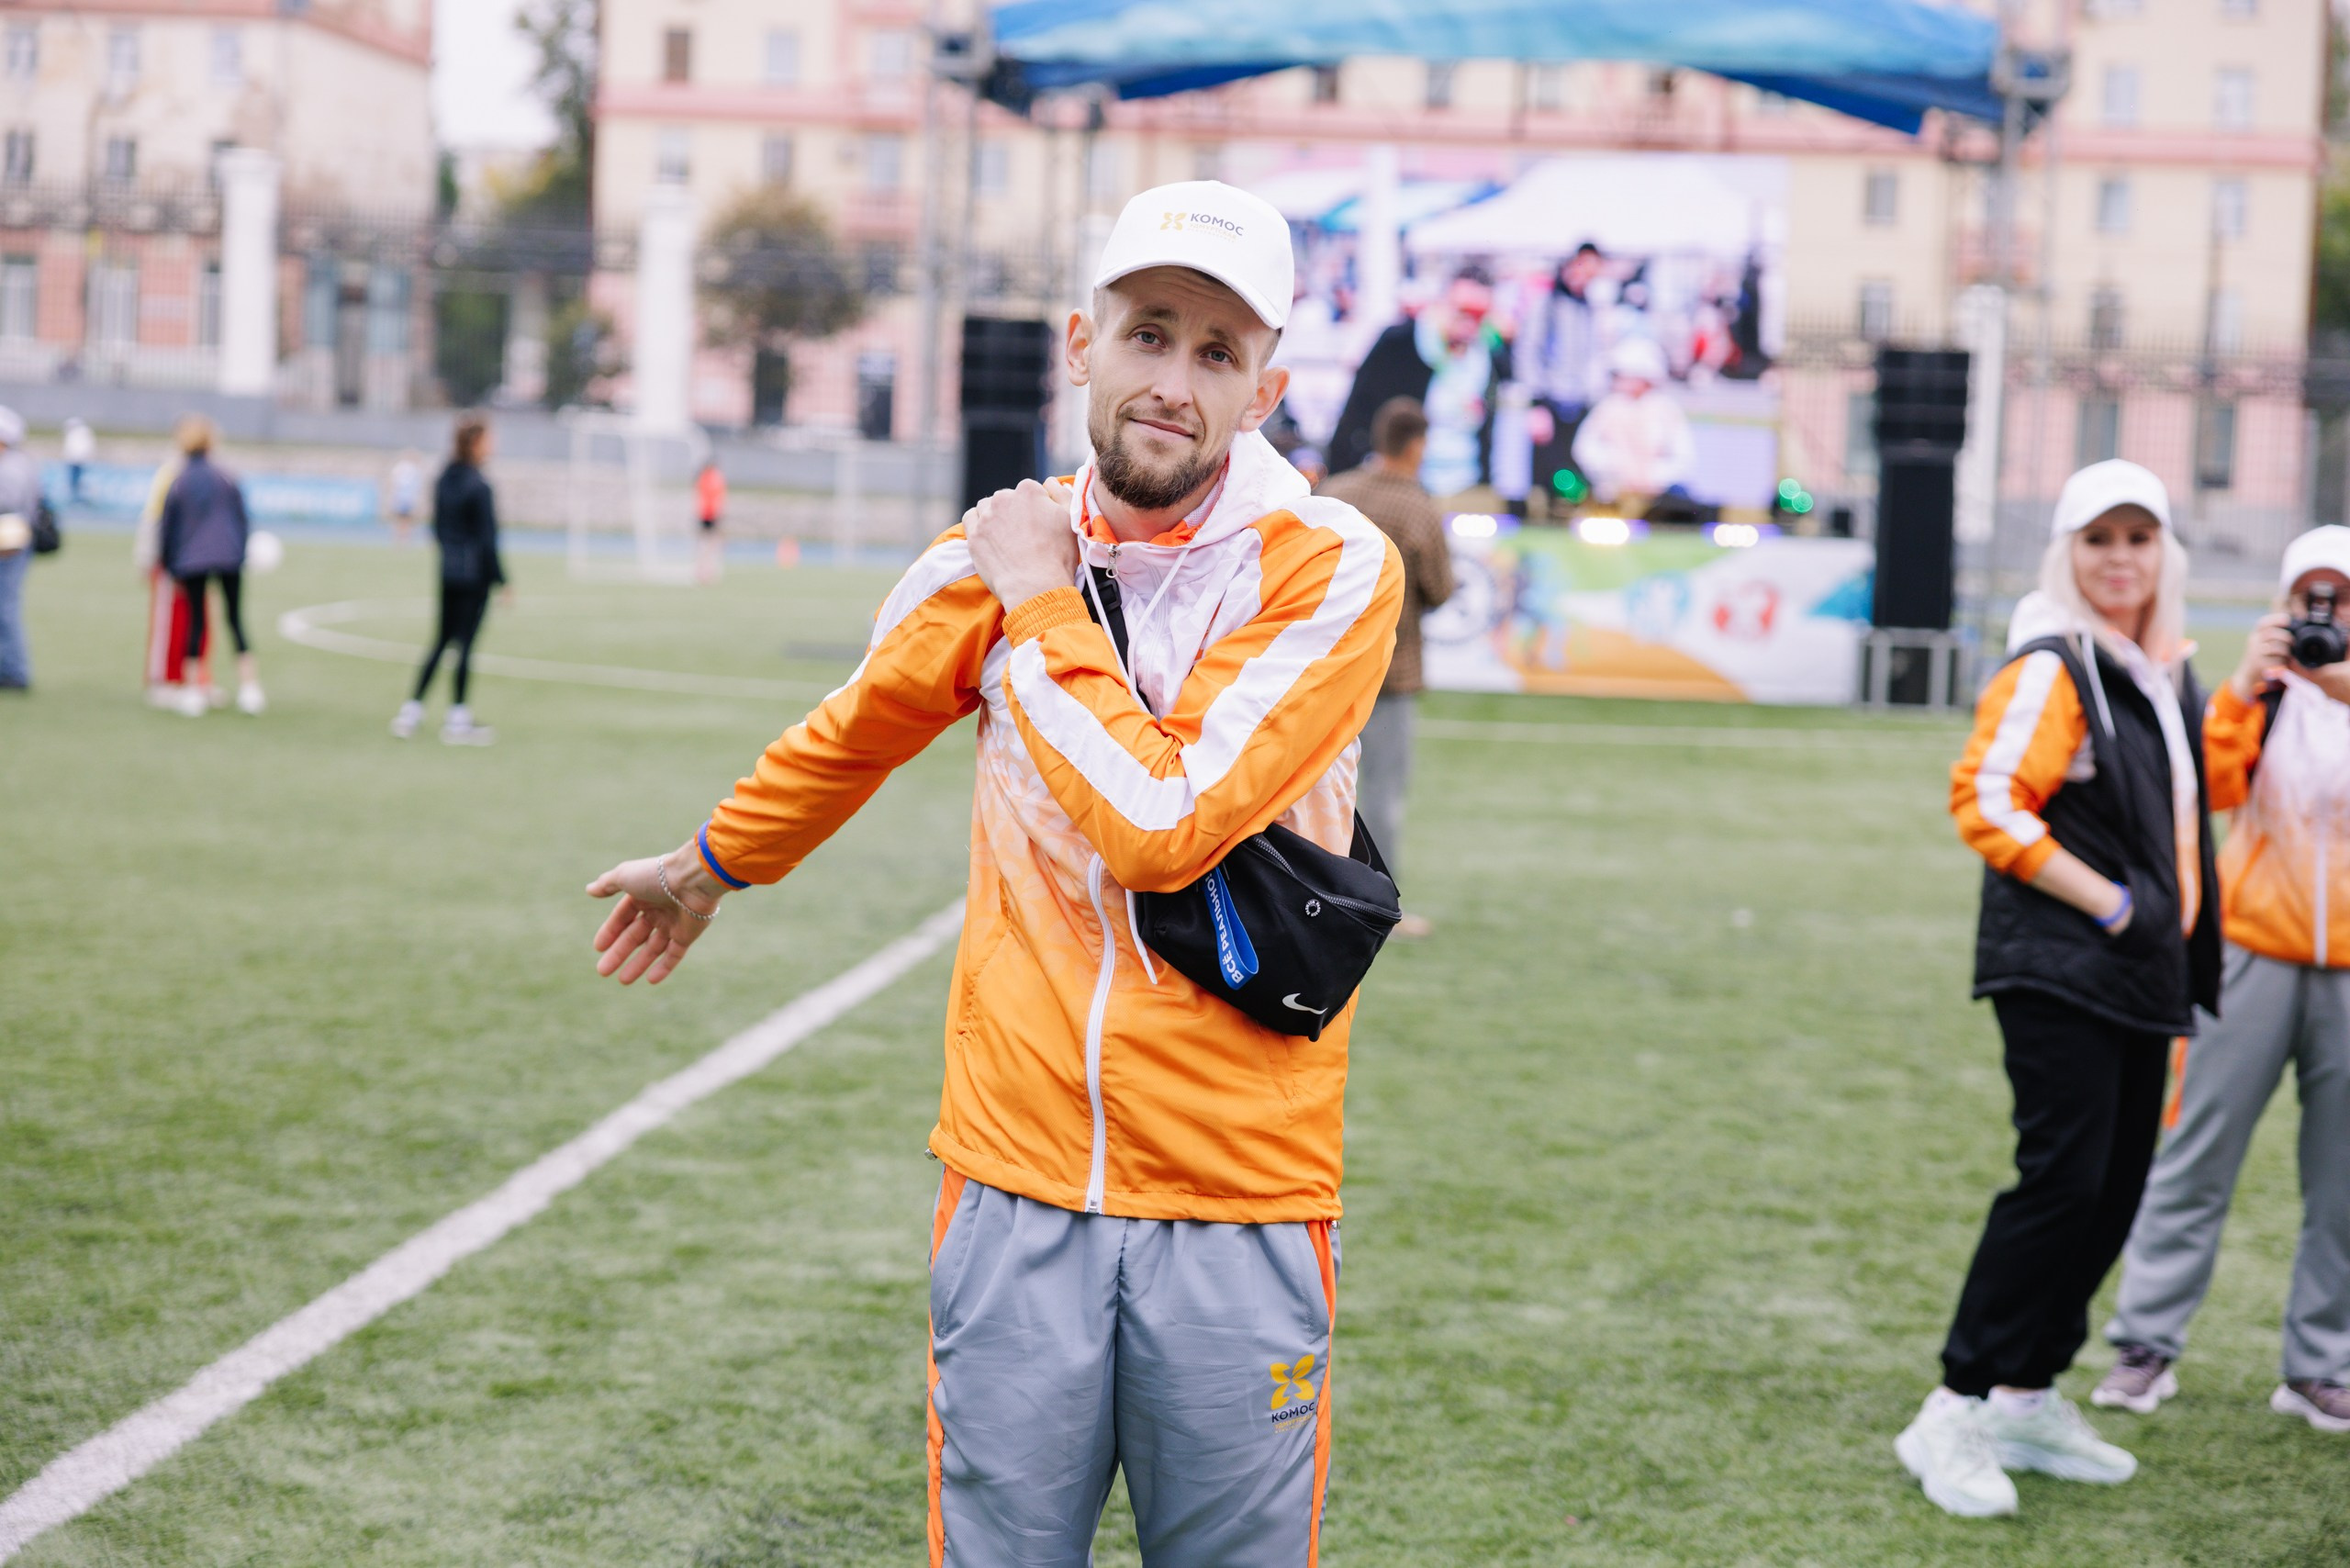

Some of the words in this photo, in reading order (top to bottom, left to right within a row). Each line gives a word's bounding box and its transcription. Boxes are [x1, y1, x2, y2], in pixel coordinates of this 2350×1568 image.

[1190, 213, 1244, 237] КОМОС
[1205, 873, 1230, 951] РЕАЛЬНО!
[1222, 950, 1245, 984] ВСЁ
[1271, 1402, 1315, 1423] КОМОС
